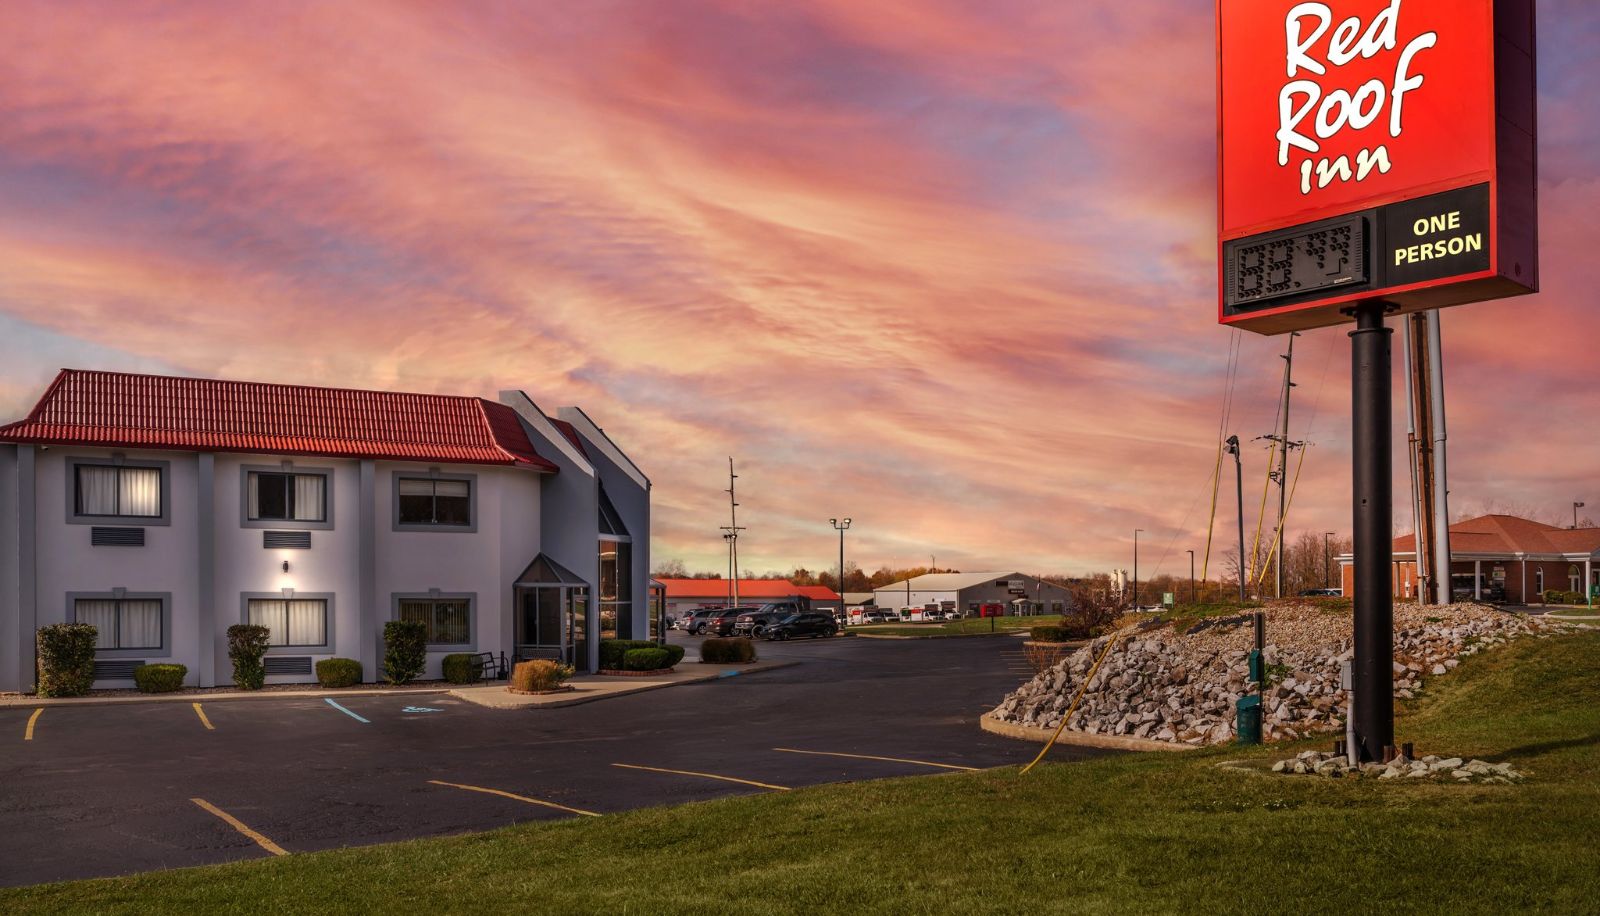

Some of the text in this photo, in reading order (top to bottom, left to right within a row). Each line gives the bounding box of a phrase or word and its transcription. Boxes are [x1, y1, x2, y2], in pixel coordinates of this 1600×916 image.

[1285, 0, 1402, 77] Red
[1275, 32, 1437, 166] Roof
[1300, 145, 1392, 194] inn
[1413, 211, 1461, 236] ONE
[1395, 233, 1482, 266] PERSON
